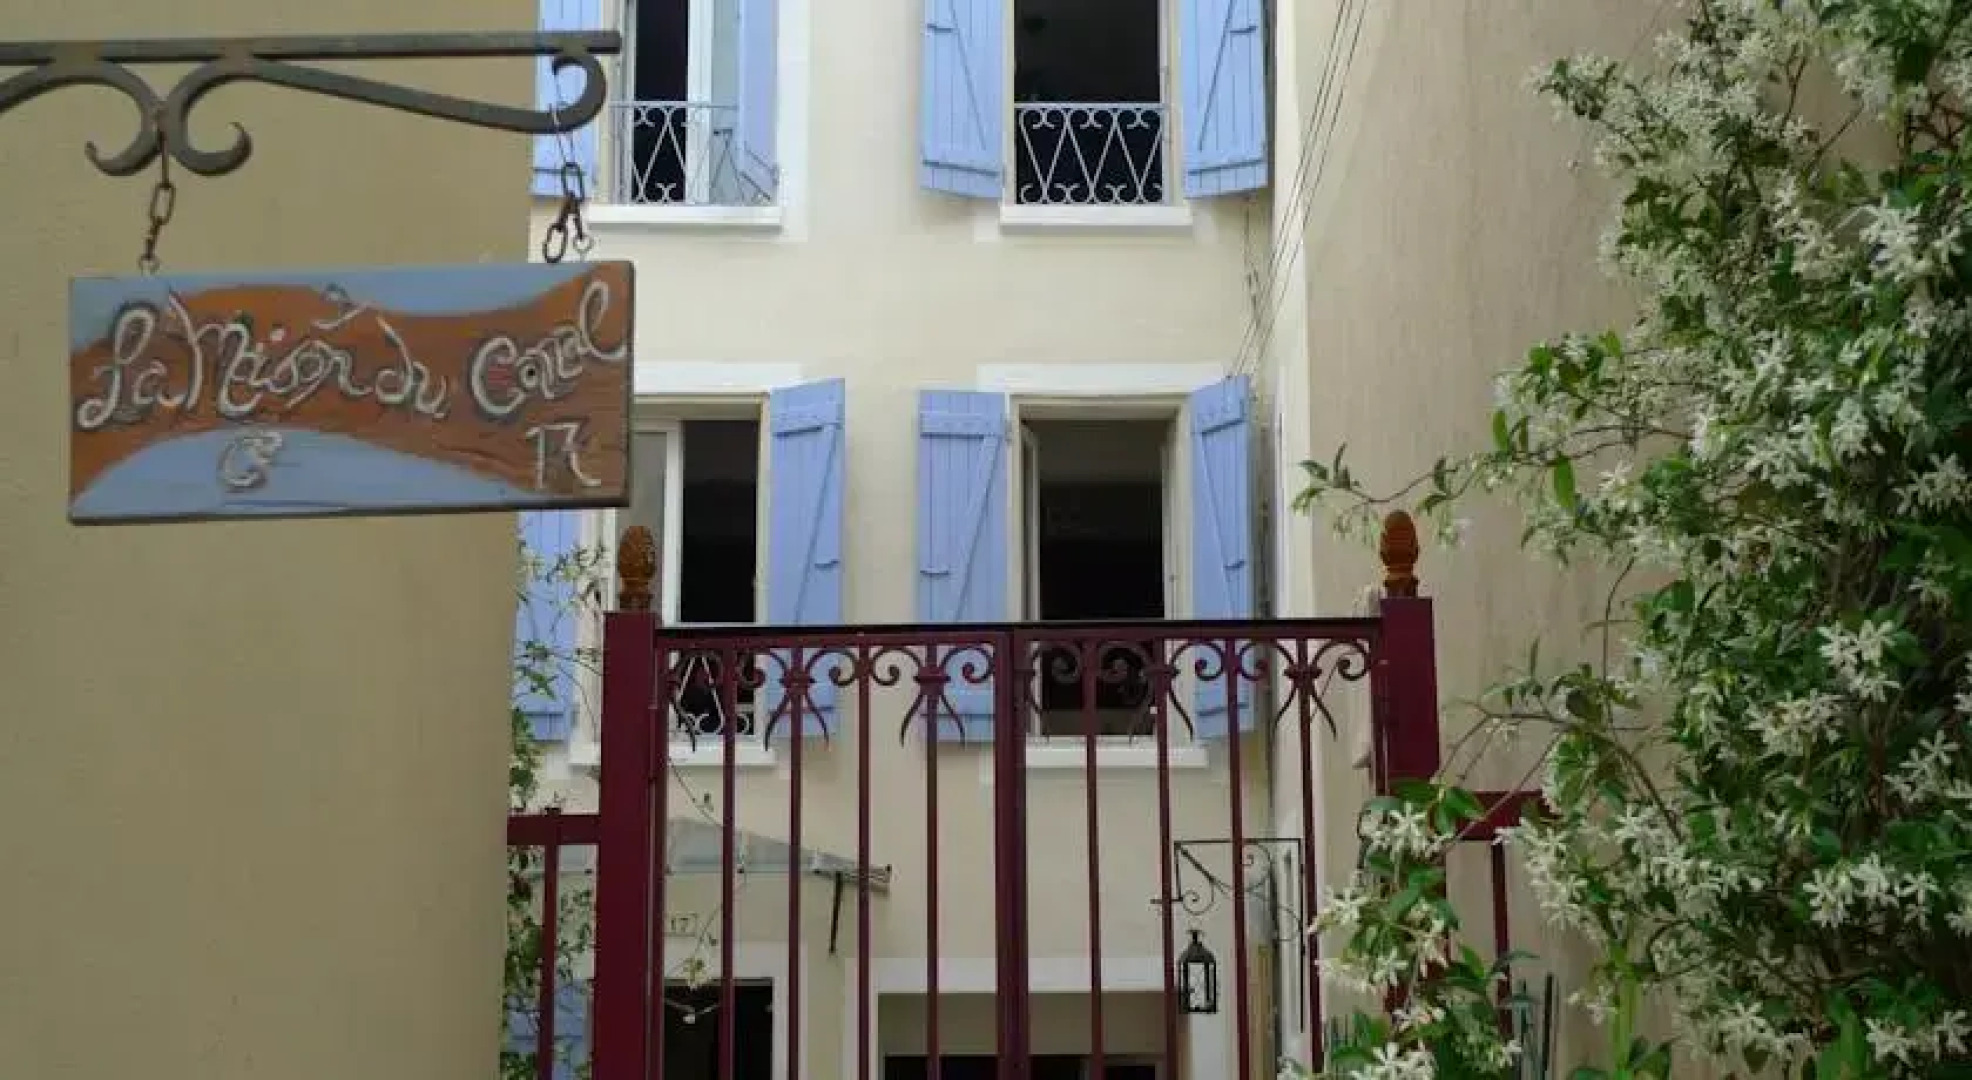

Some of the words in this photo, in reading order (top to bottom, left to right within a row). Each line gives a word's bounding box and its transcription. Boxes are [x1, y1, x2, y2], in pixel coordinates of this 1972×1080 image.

[77, 308, 190, 429] La
[168, 288, 373, 414] Maison
[375, 315, 448, 418] du
[471, 281, 627, 416] Canal
[670, 917, 689, 933] 17
